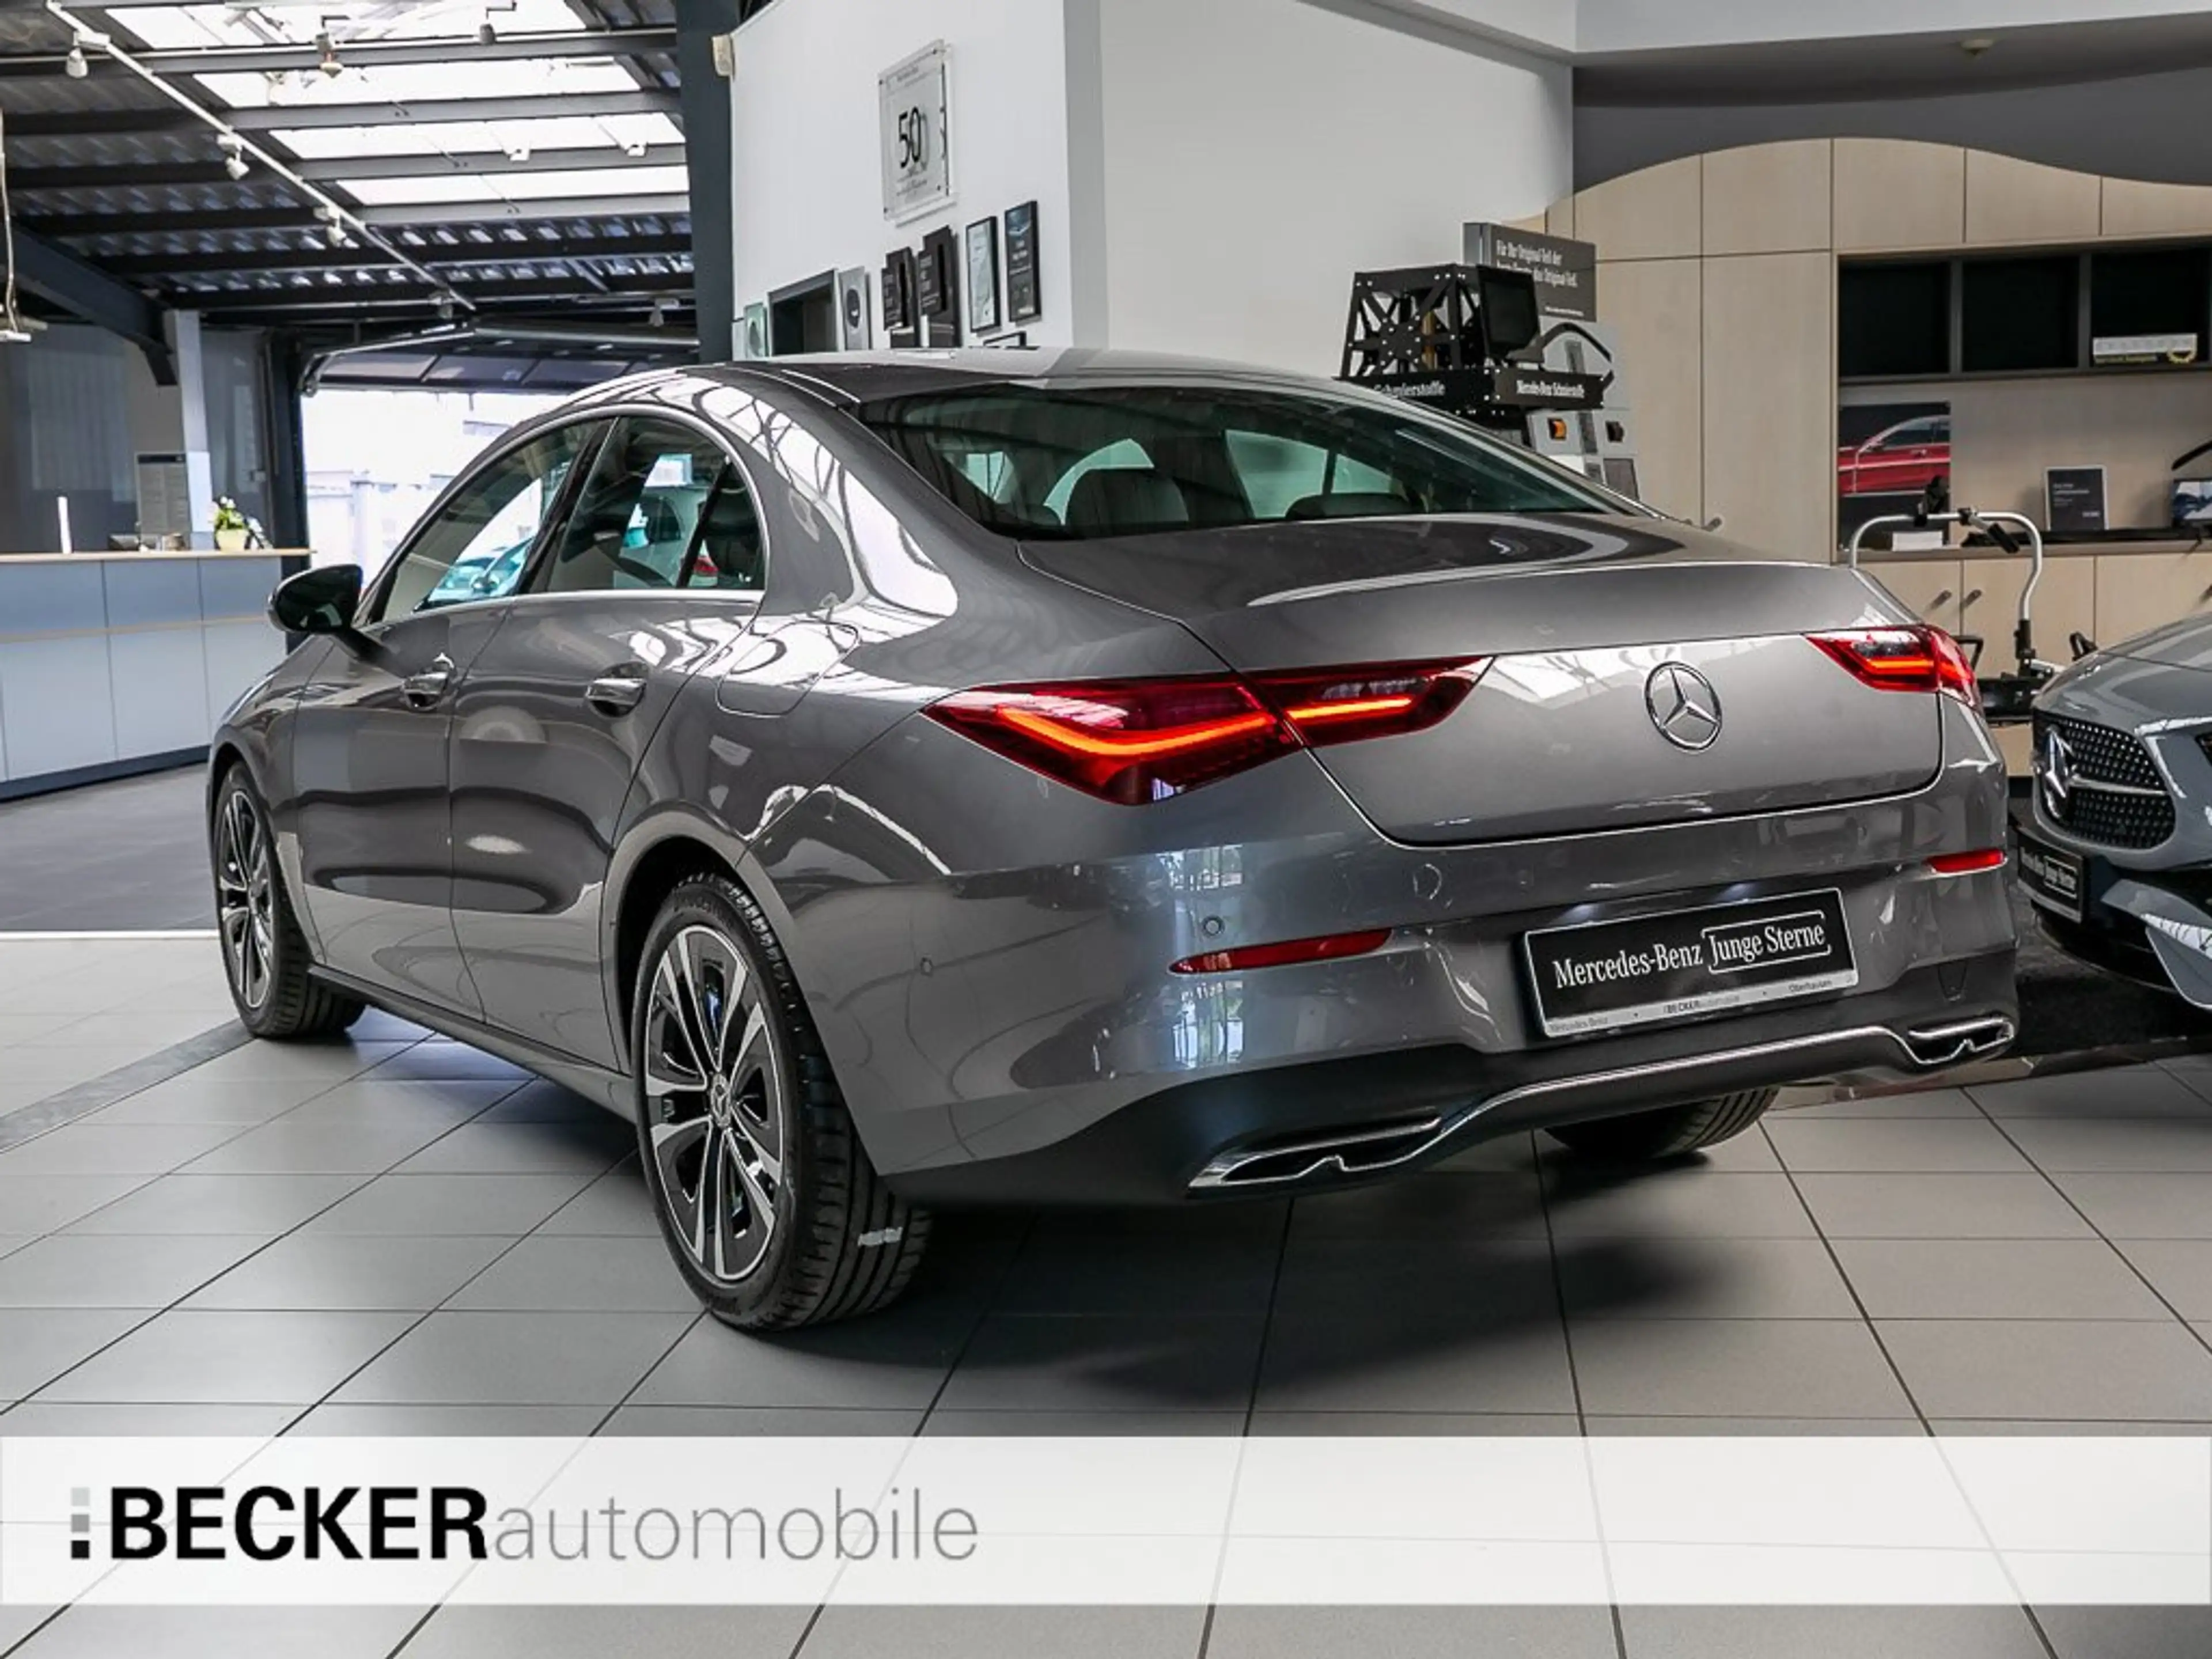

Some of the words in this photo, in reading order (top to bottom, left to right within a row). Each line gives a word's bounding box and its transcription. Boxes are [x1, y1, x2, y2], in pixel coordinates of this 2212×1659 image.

[898, 106, 922, 168] 50
[1552, 942, 1704, 988] Mercedes-Benz
[1708, 934, 1764, 967] Junge
[1764, 925, 1825, 953] Sterne
